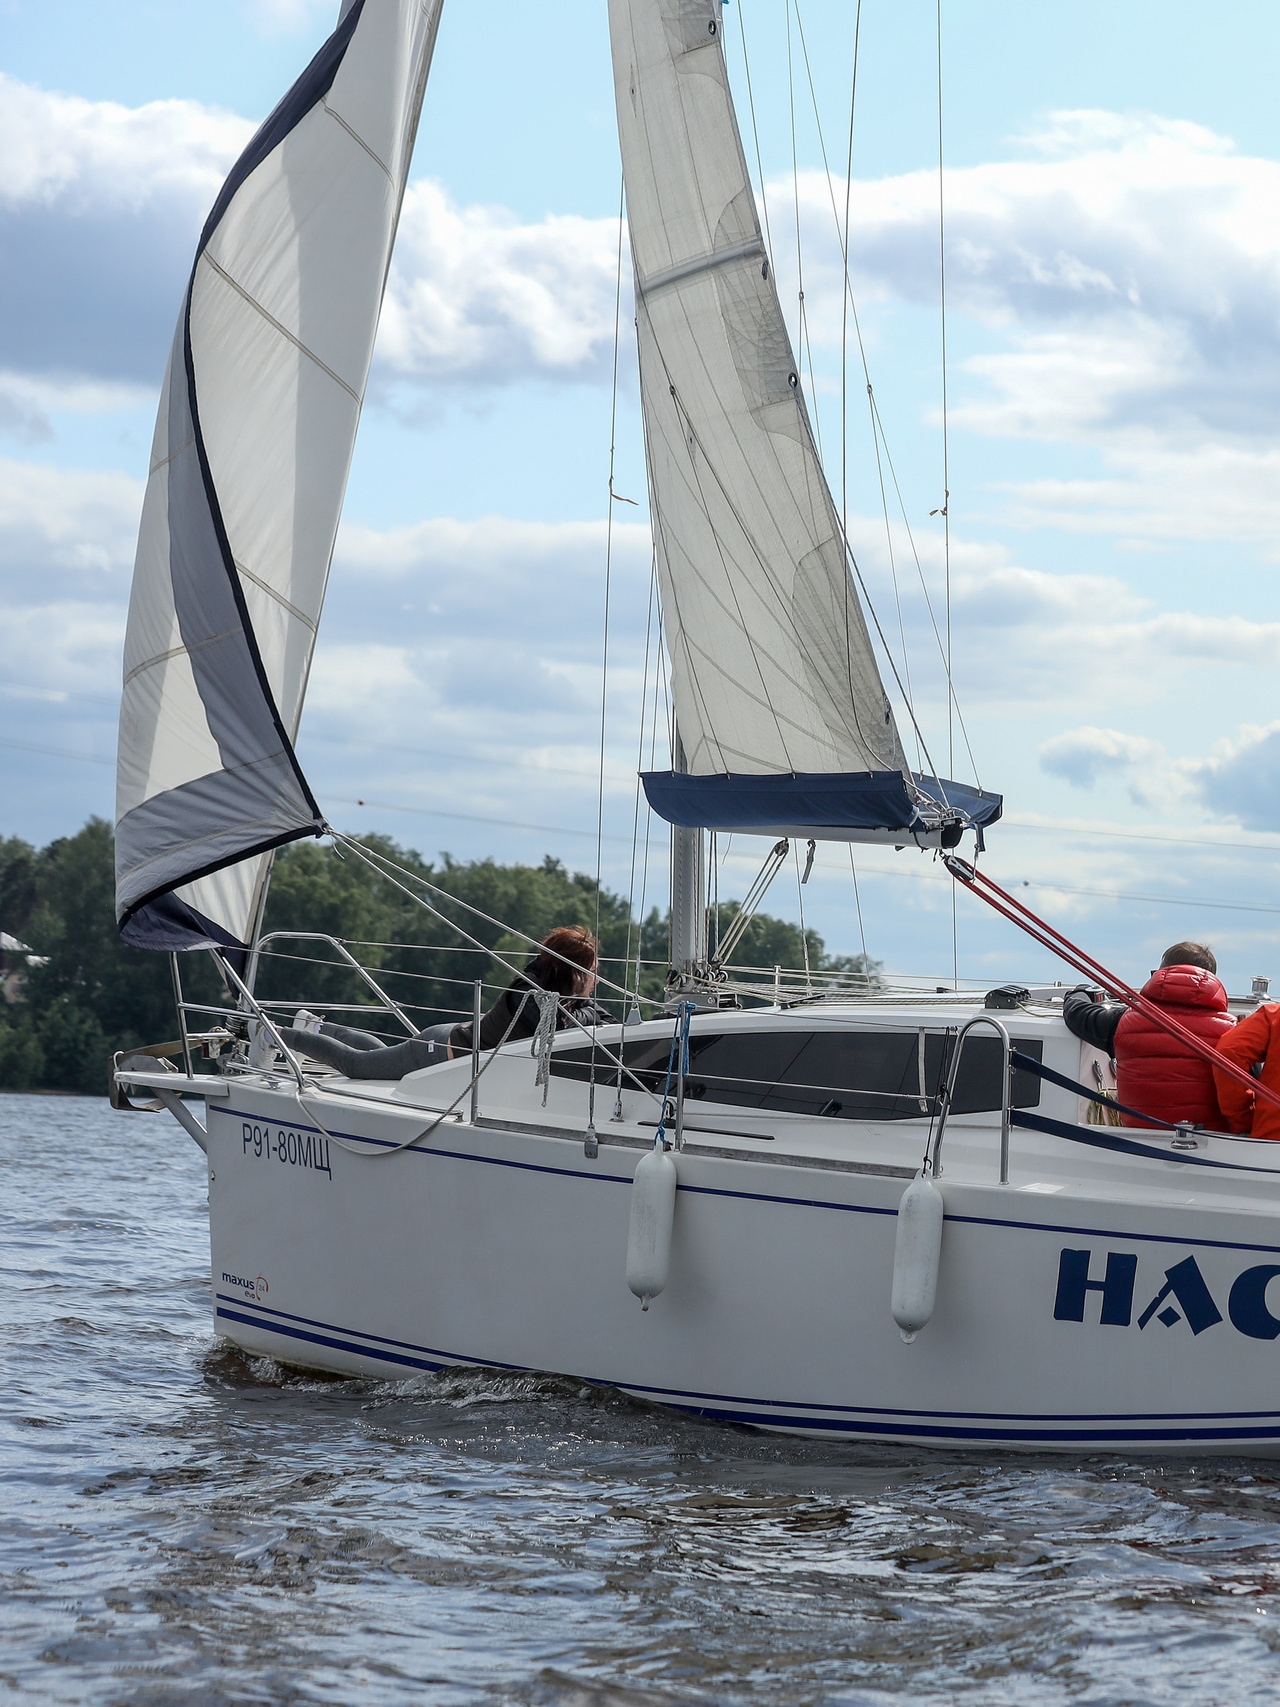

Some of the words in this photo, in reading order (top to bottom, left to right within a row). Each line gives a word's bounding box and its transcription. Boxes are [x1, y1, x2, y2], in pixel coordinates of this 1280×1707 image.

[242, 1123, 332, 1181] Р91-80МЩ
[222, 1272, 255, 1290] maxus
[244, 1290, 256, 1299] evo
